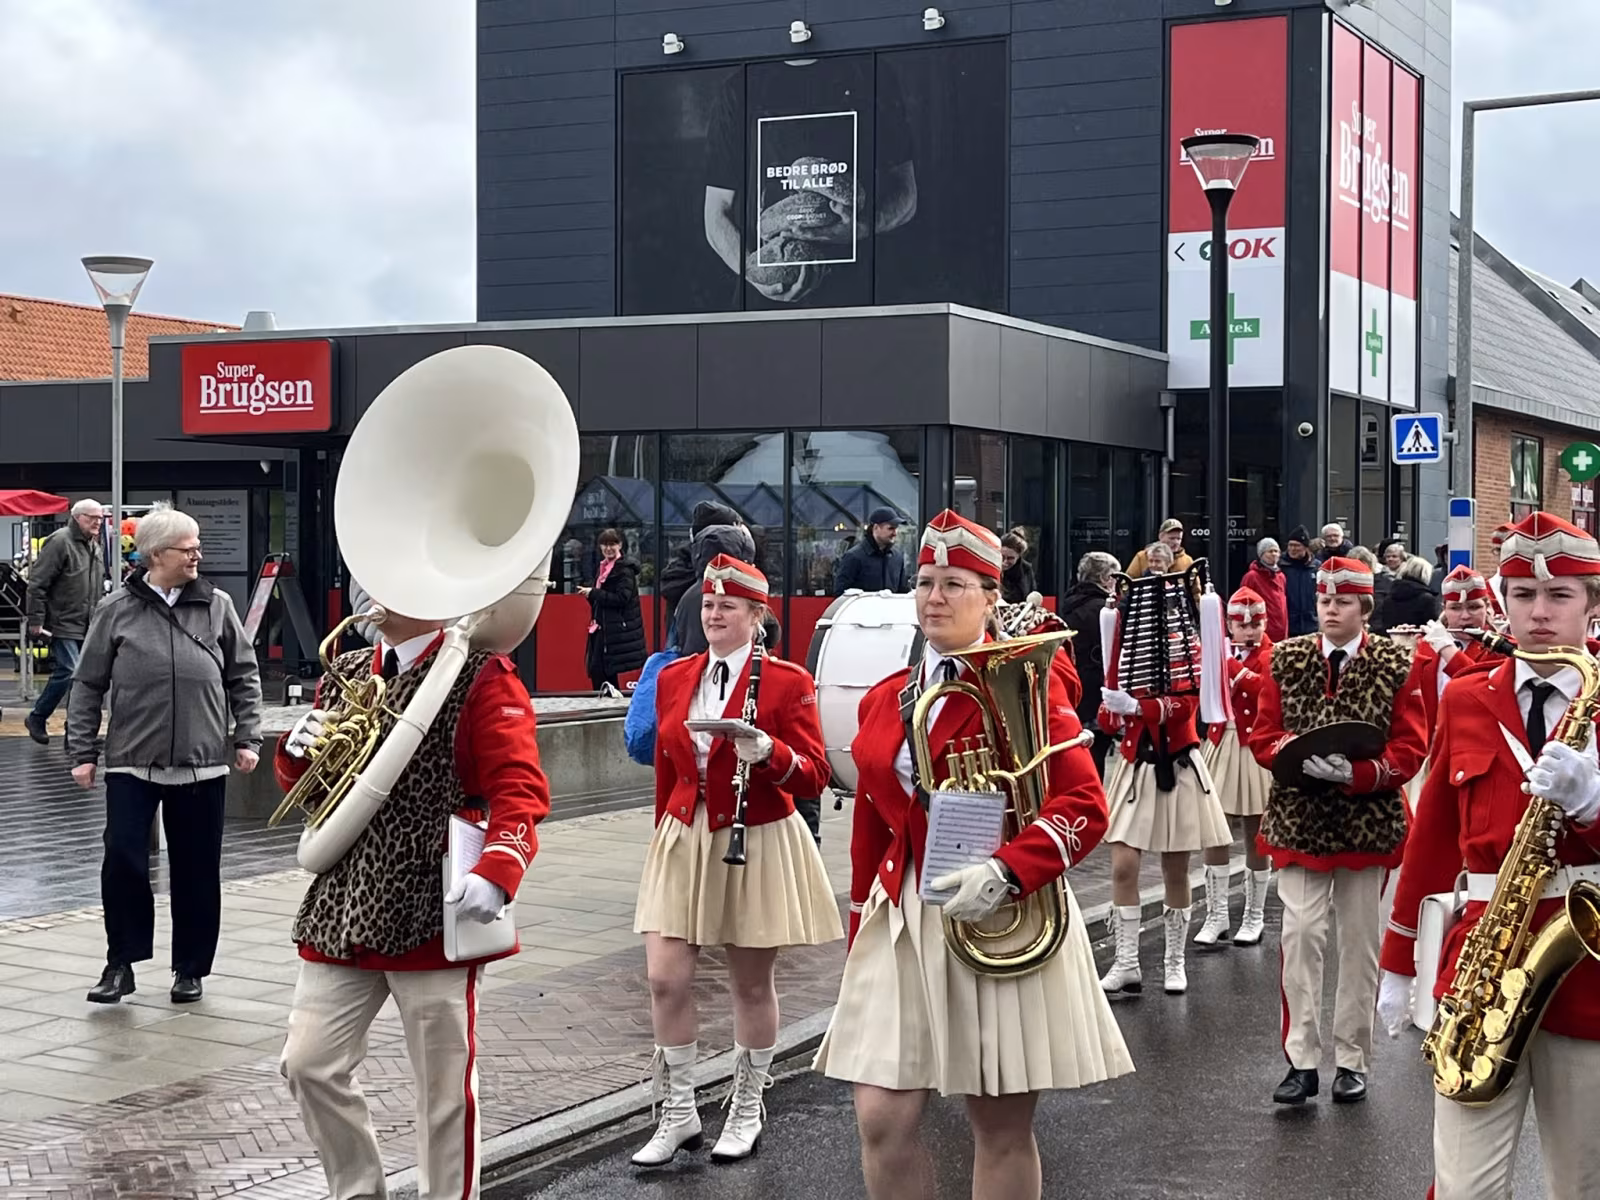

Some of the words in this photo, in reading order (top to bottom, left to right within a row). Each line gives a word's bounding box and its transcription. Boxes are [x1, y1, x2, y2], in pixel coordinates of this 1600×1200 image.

[766, 165, 808, 178] BEDRE
[811, 162, 848, 175] BRØD
[1339, 120, 1409, 223] Brugsen
[780, 179, 800, 190] TIL
[802, 176, 834, 189] ALLE
[1228, 236, 1277, 260] OK
[1199, 322, 1253, 335] Atek
[216, 361, 256, 381] Super
[199, 374, 314, 415] Brugsen
